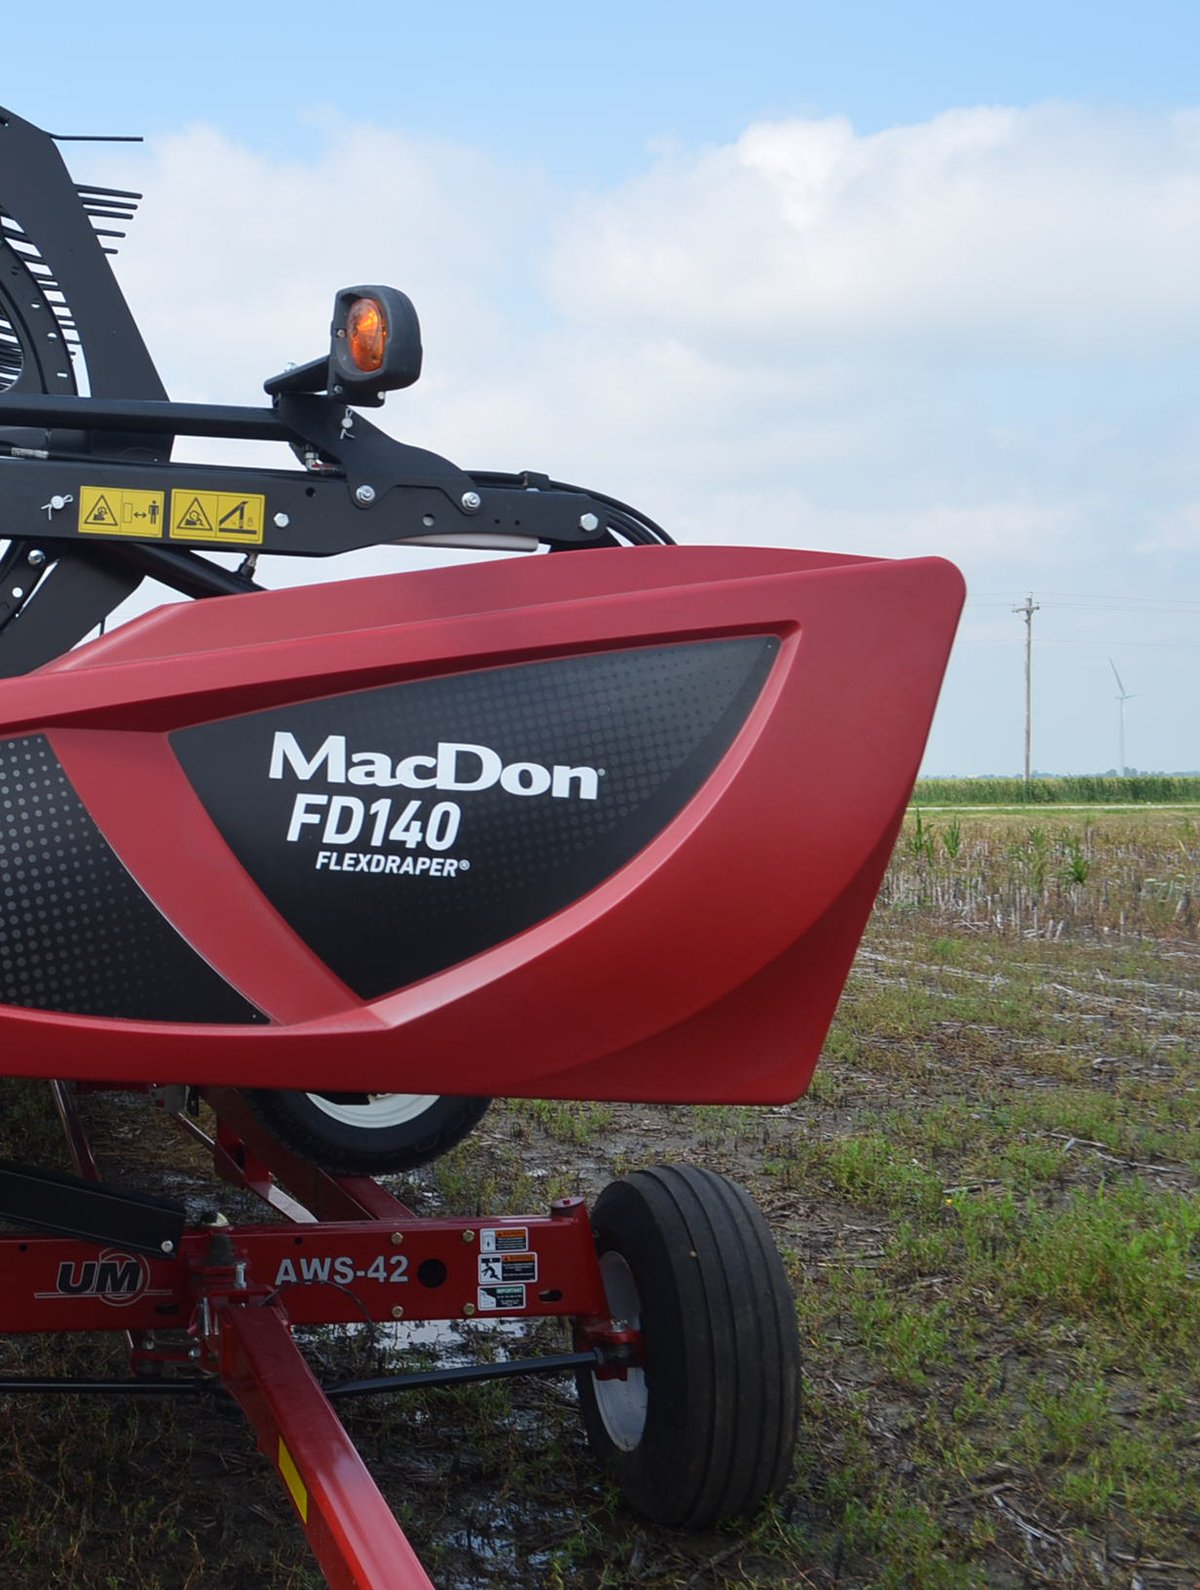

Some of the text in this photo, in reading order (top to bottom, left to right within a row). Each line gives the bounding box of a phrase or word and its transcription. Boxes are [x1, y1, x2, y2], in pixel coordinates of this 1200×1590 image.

[286, 793, 462, 851] FD140
[56, 1261, 142, 1295] UM
[274, 1255, 409, 1286] AWS-42
